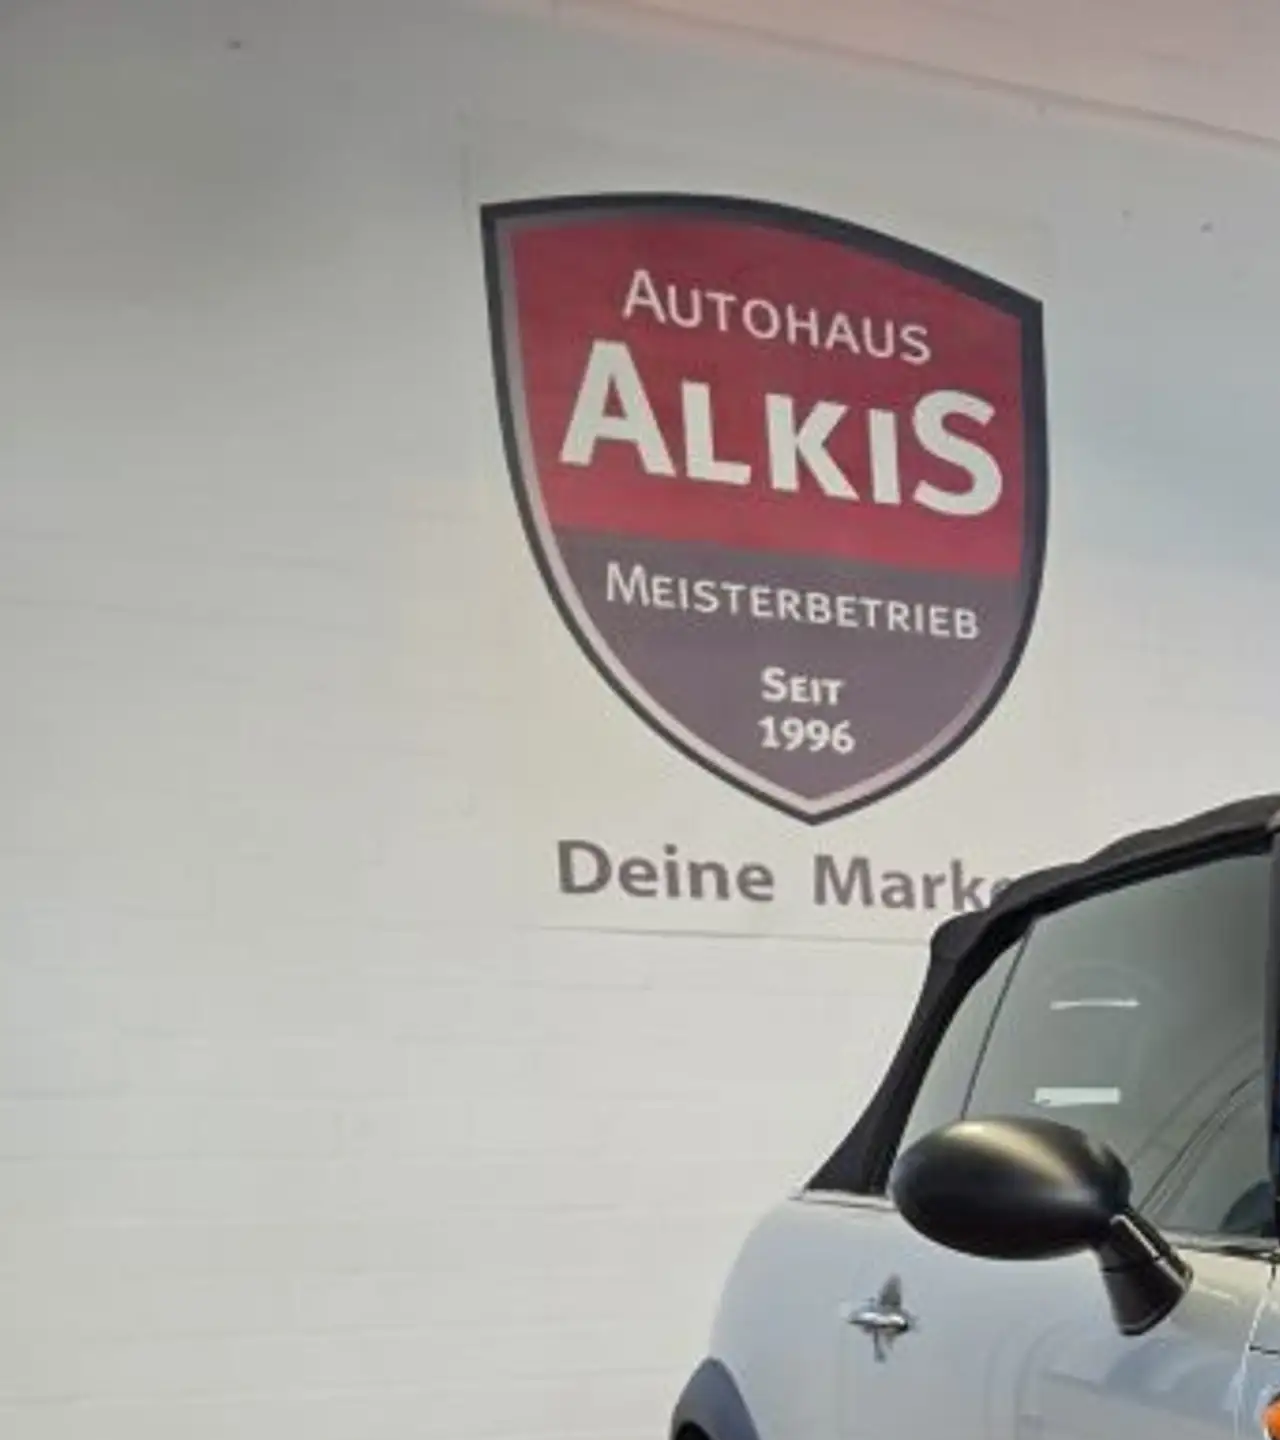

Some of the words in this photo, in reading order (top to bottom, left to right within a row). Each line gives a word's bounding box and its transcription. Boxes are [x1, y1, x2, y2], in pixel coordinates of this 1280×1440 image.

[622, 268, 933, 366] AUTOHAUS
[558, 338, 1003, 517] ALKIS
[605, 561, 981, 641] MEISTERBETRIEB
[760, 666, 845, 707] SEIT
[758, 716, 857, 754] 1996
[556, 838, 776, 901] Deine
